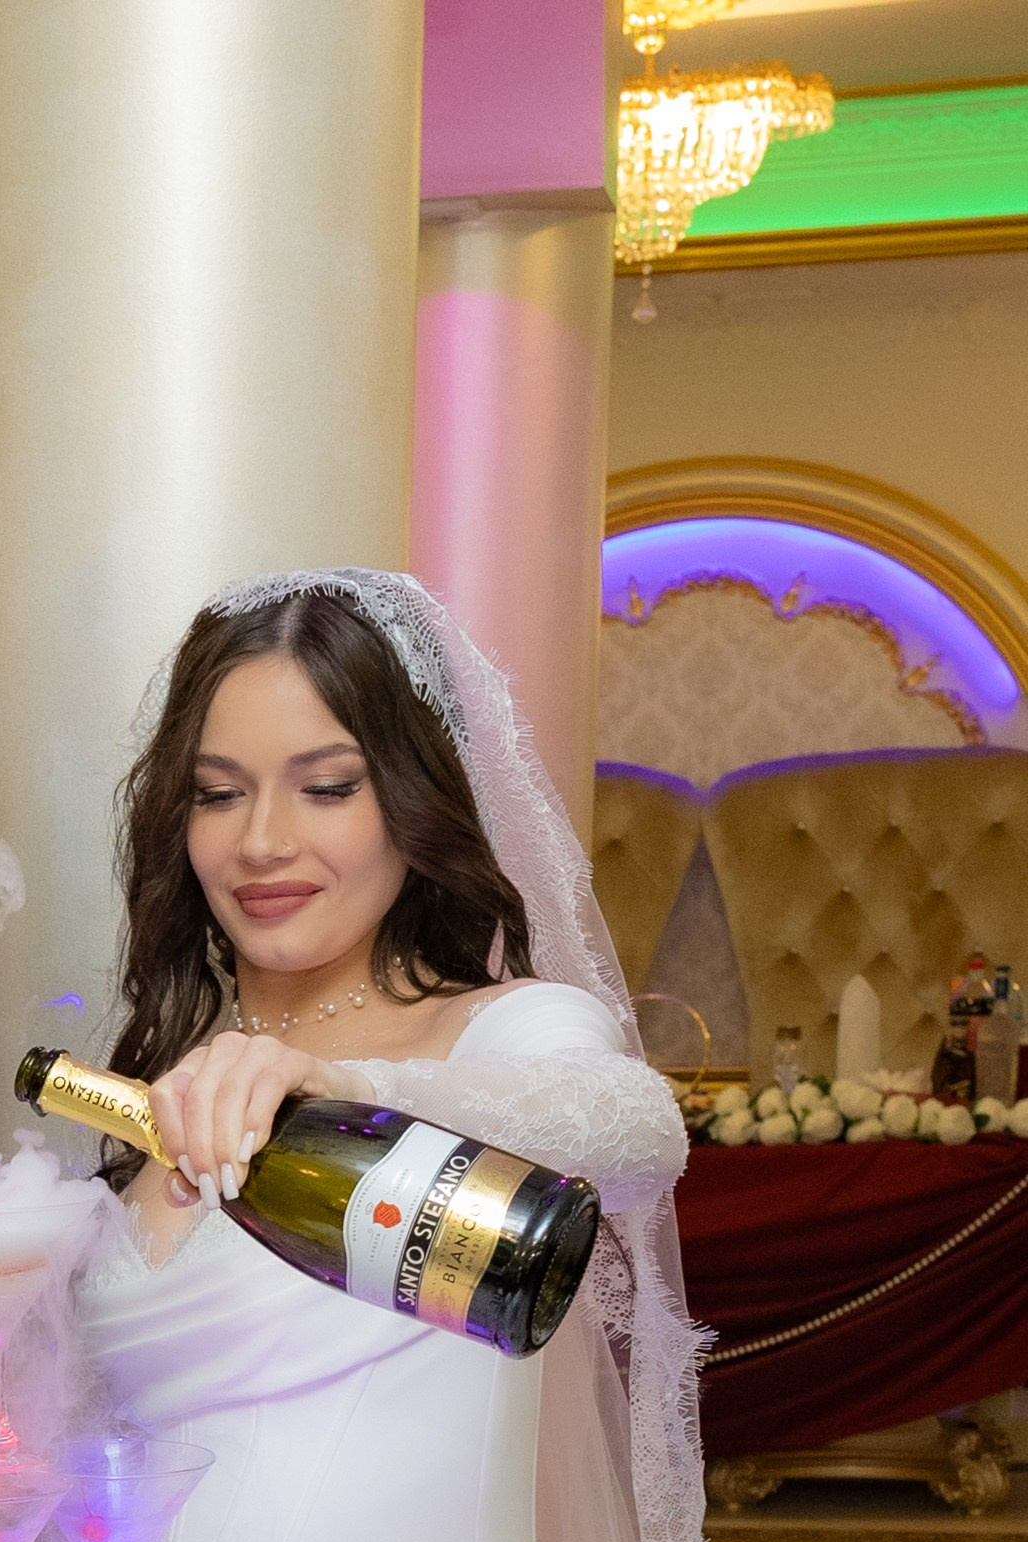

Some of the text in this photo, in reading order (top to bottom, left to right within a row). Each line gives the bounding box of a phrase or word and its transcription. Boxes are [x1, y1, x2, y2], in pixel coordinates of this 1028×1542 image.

[52, 1076, 159, 1135] ANTO STEFANO
[397, 1244, 425, 1307] SANTO
[414, 1154, 471, 1240] STEFANO
[442, 1203, 483, 1284] BIANCO
